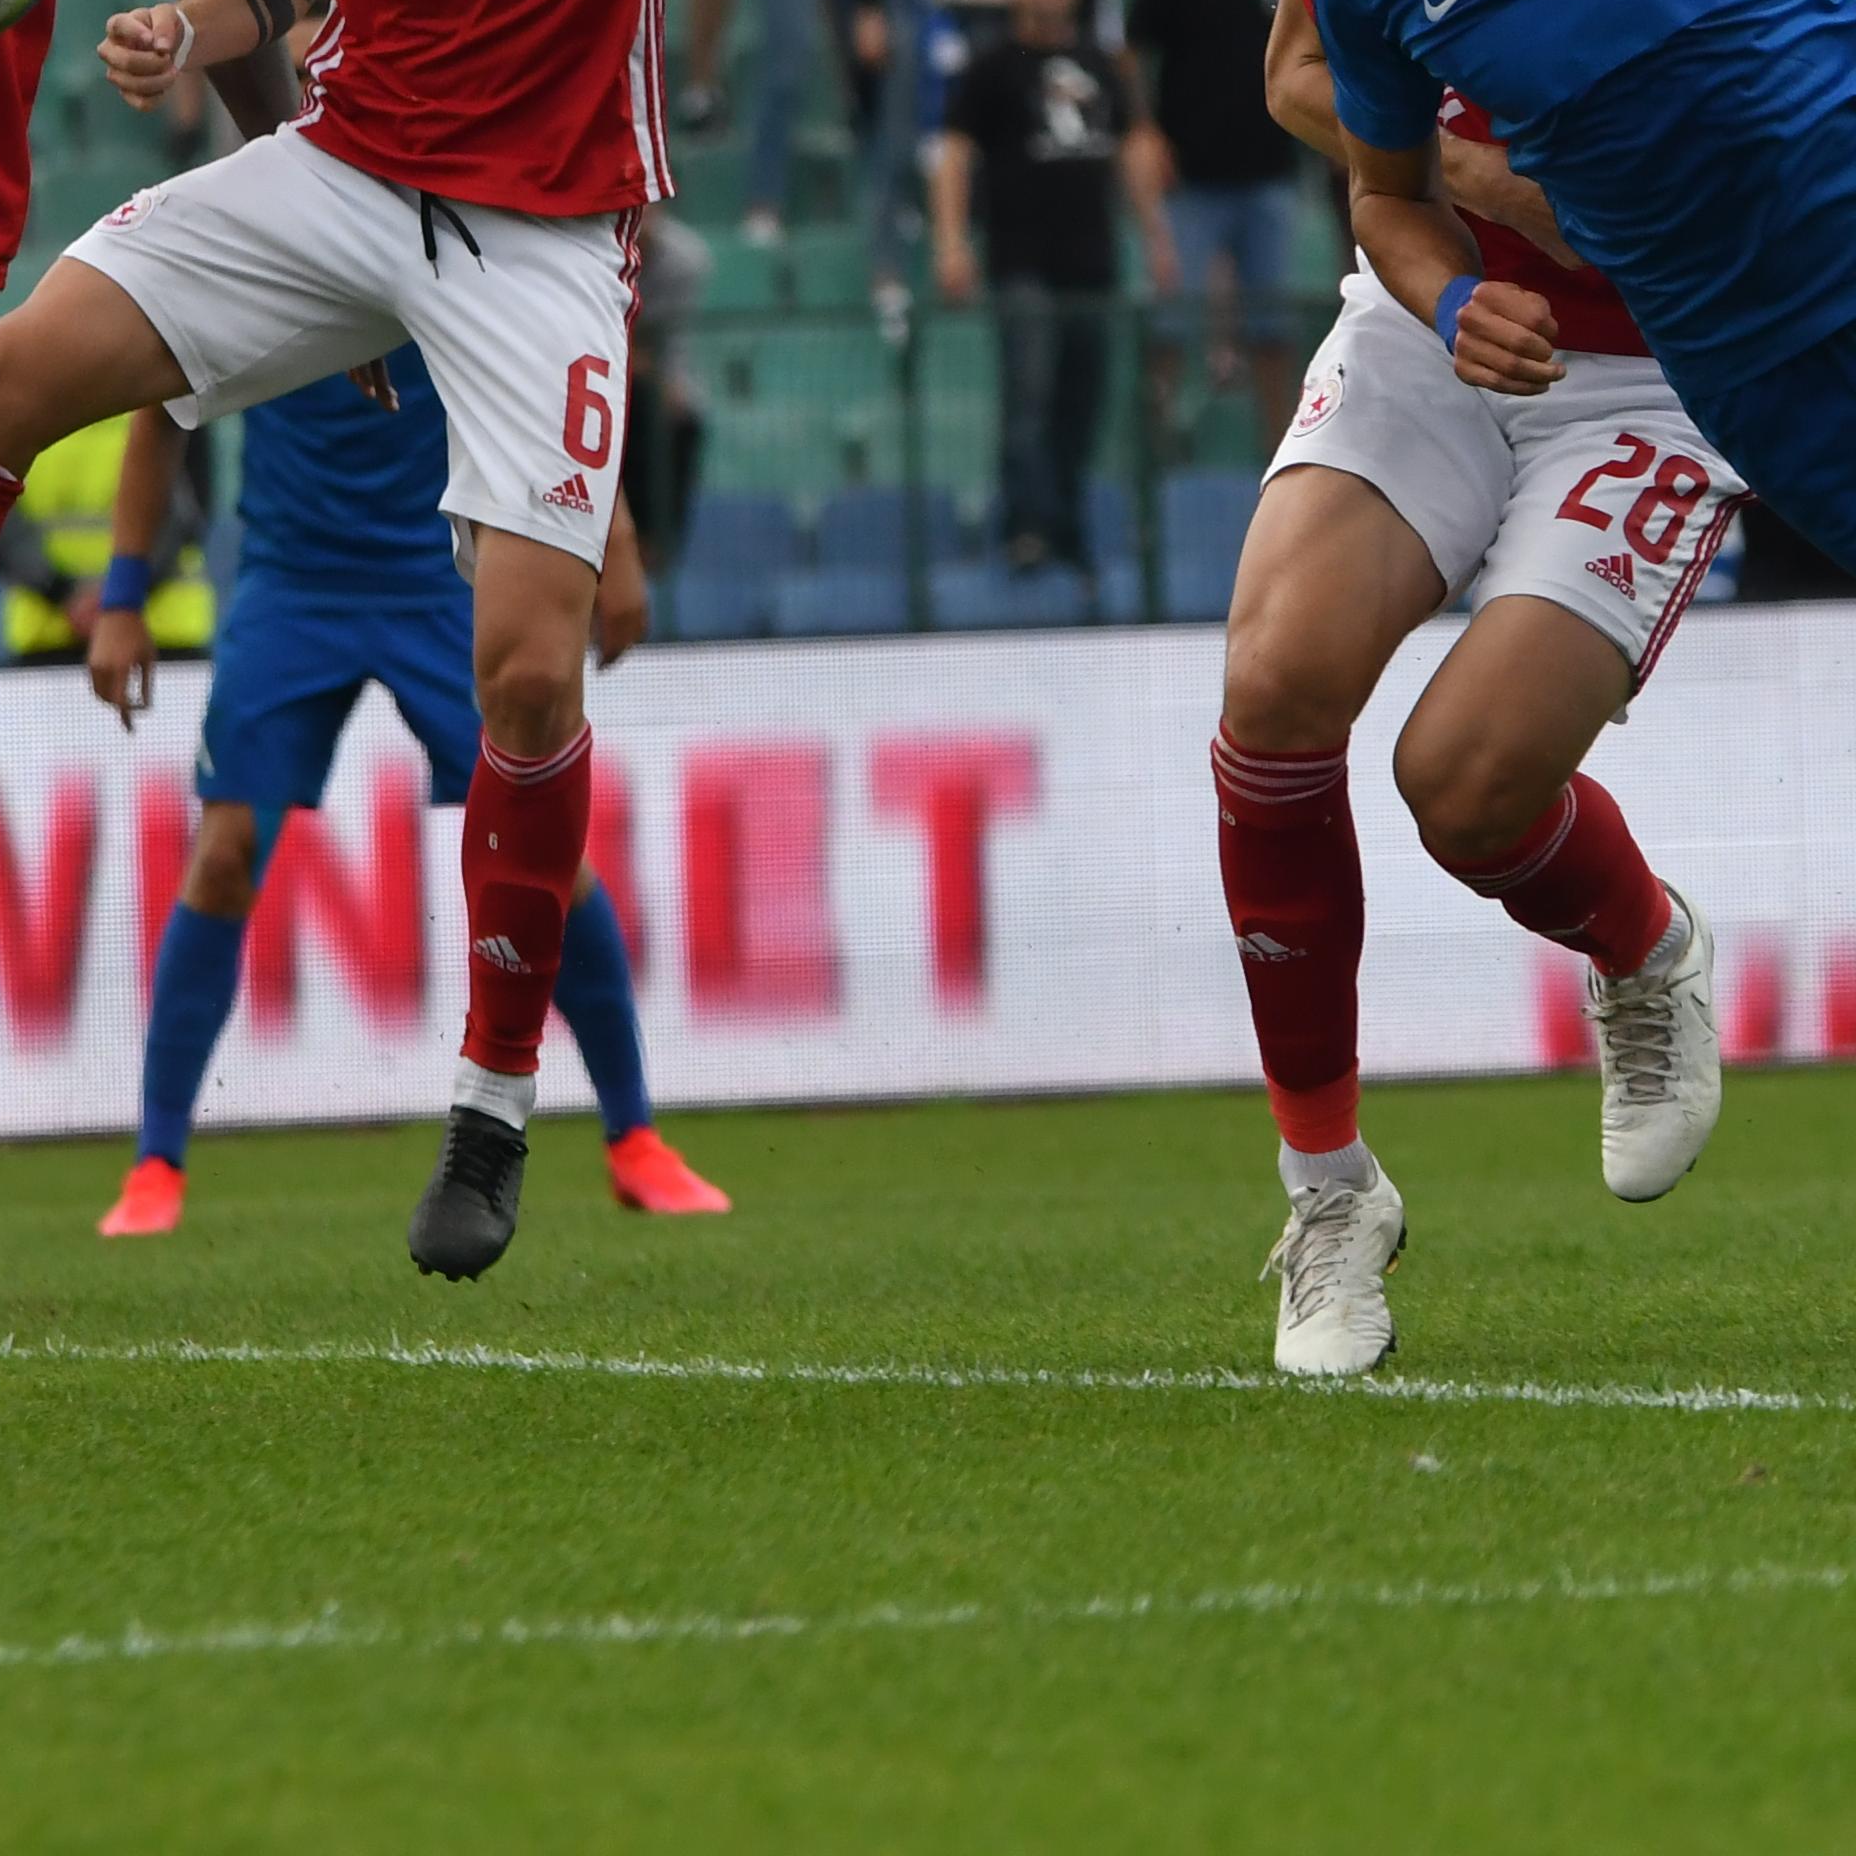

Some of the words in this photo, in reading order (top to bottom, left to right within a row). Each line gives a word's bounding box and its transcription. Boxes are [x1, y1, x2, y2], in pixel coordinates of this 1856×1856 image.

[563, 354, 612, 470] 6
[543, 491, 595, 515] adidas
[1555, 432, 1711, 565] 28
[1584, 560, 1637, 601] adidas
